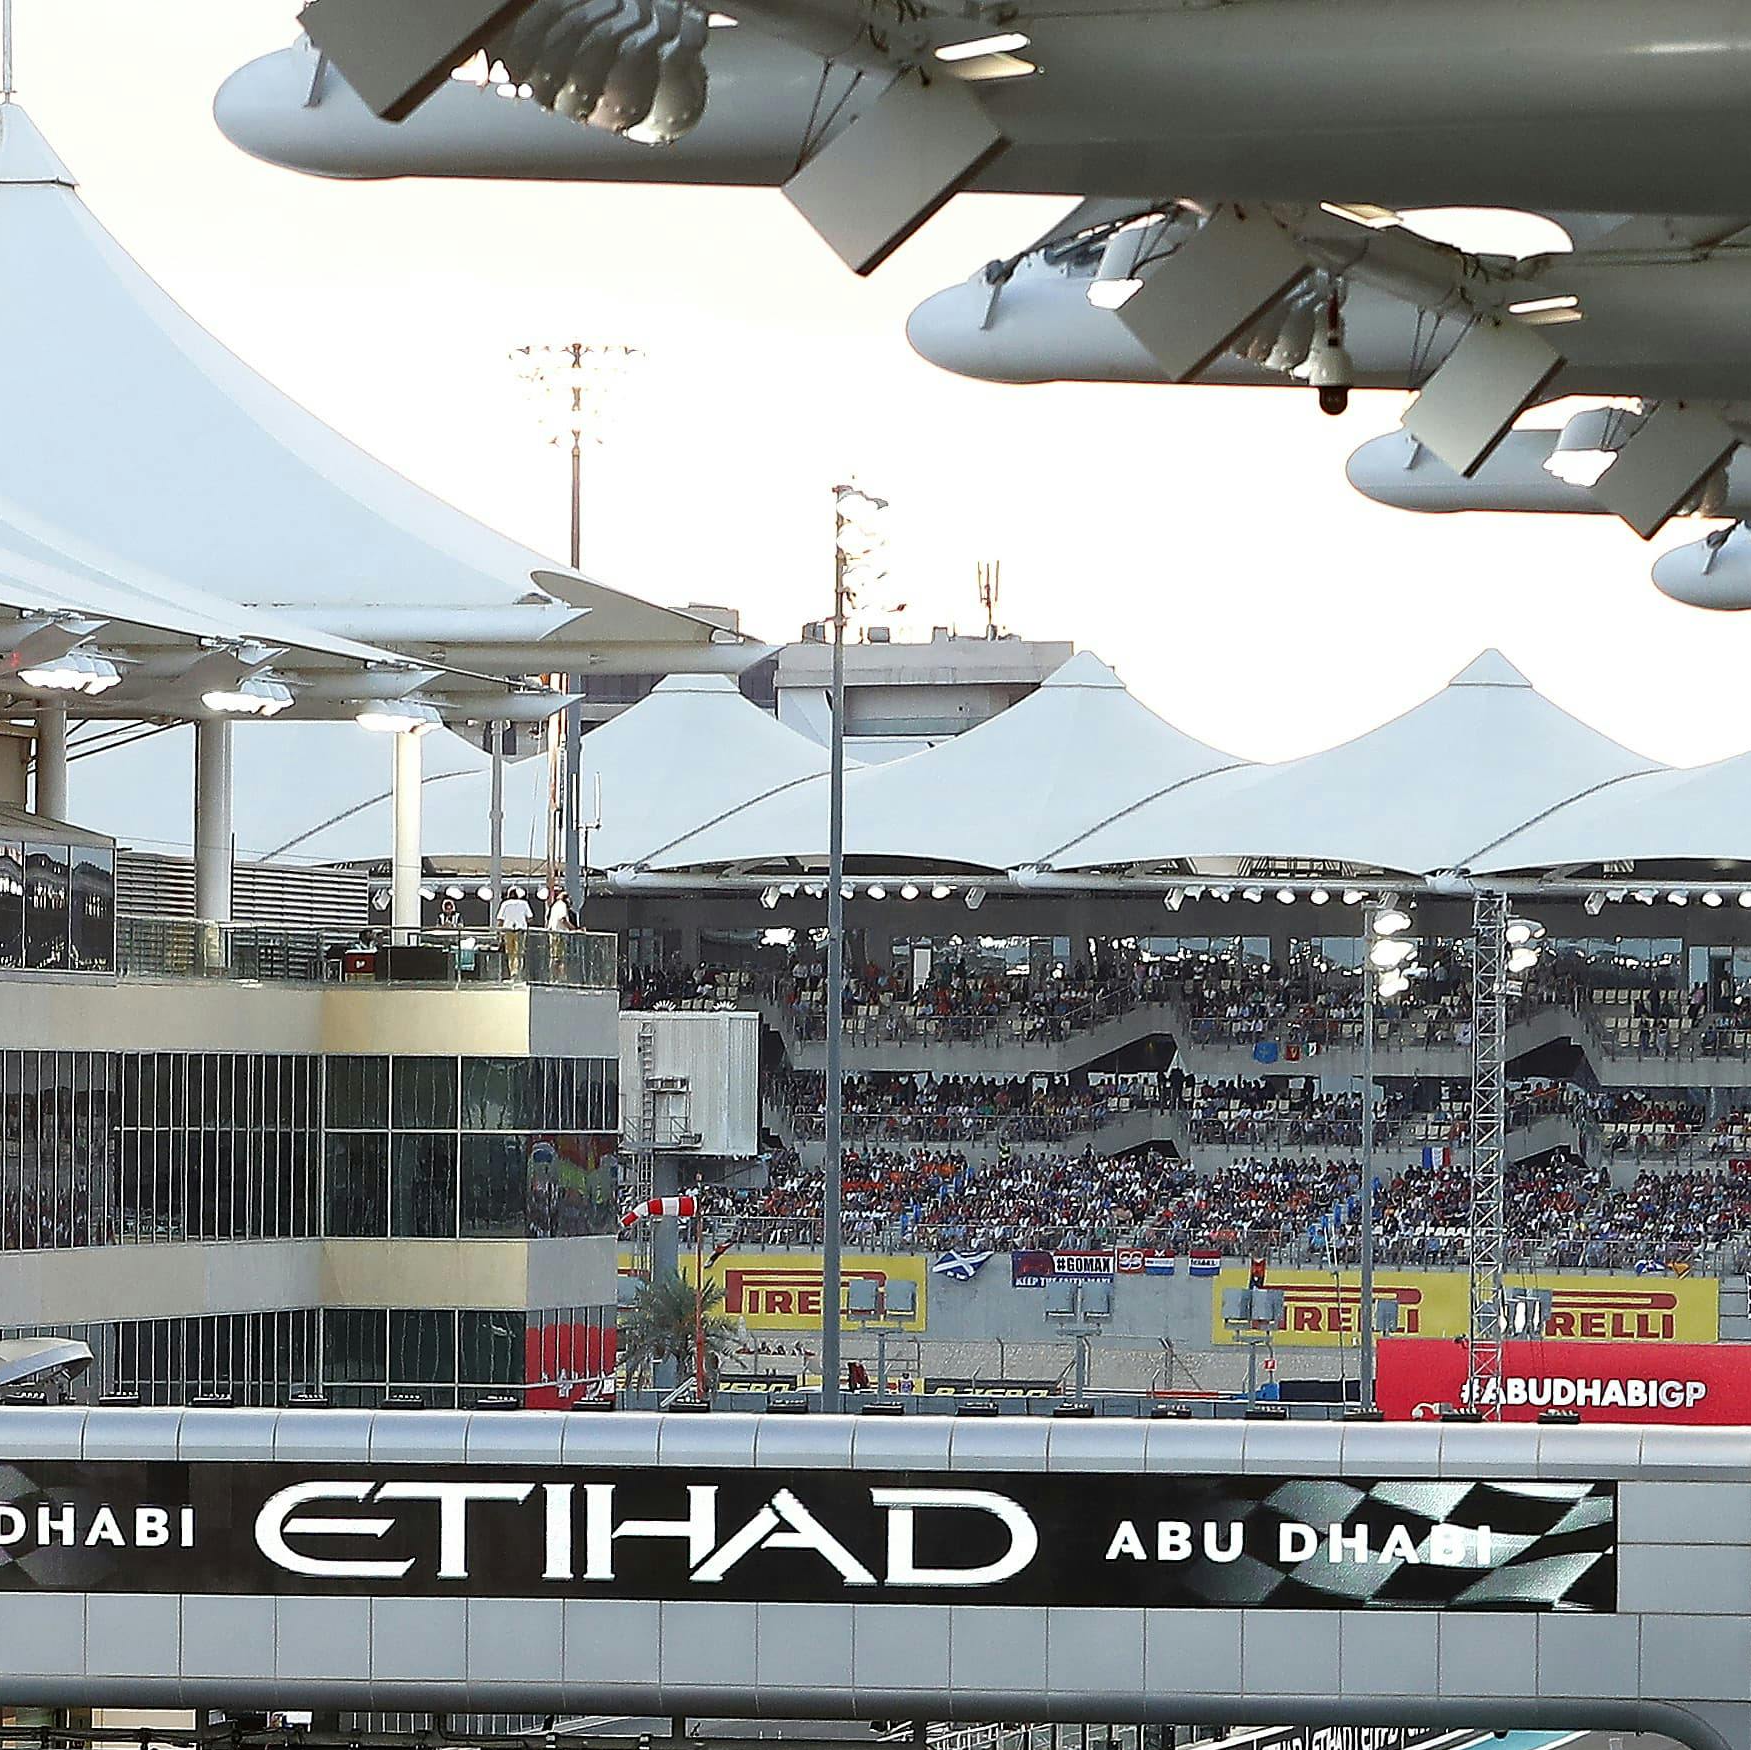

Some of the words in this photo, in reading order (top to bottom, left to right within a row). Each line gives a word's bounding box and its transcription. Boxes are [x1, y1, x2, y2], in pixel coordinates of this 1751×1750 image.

[1056, 1257, 1111, 1273] #GOMAX
[725, 1269, 887, 1315] PIREI
[253, 1481, 1039, 1587] ETIHAD
[1105, 1520, 1245, 1565] ABU
[1278, 1523, 1495, 1569] DHABI
